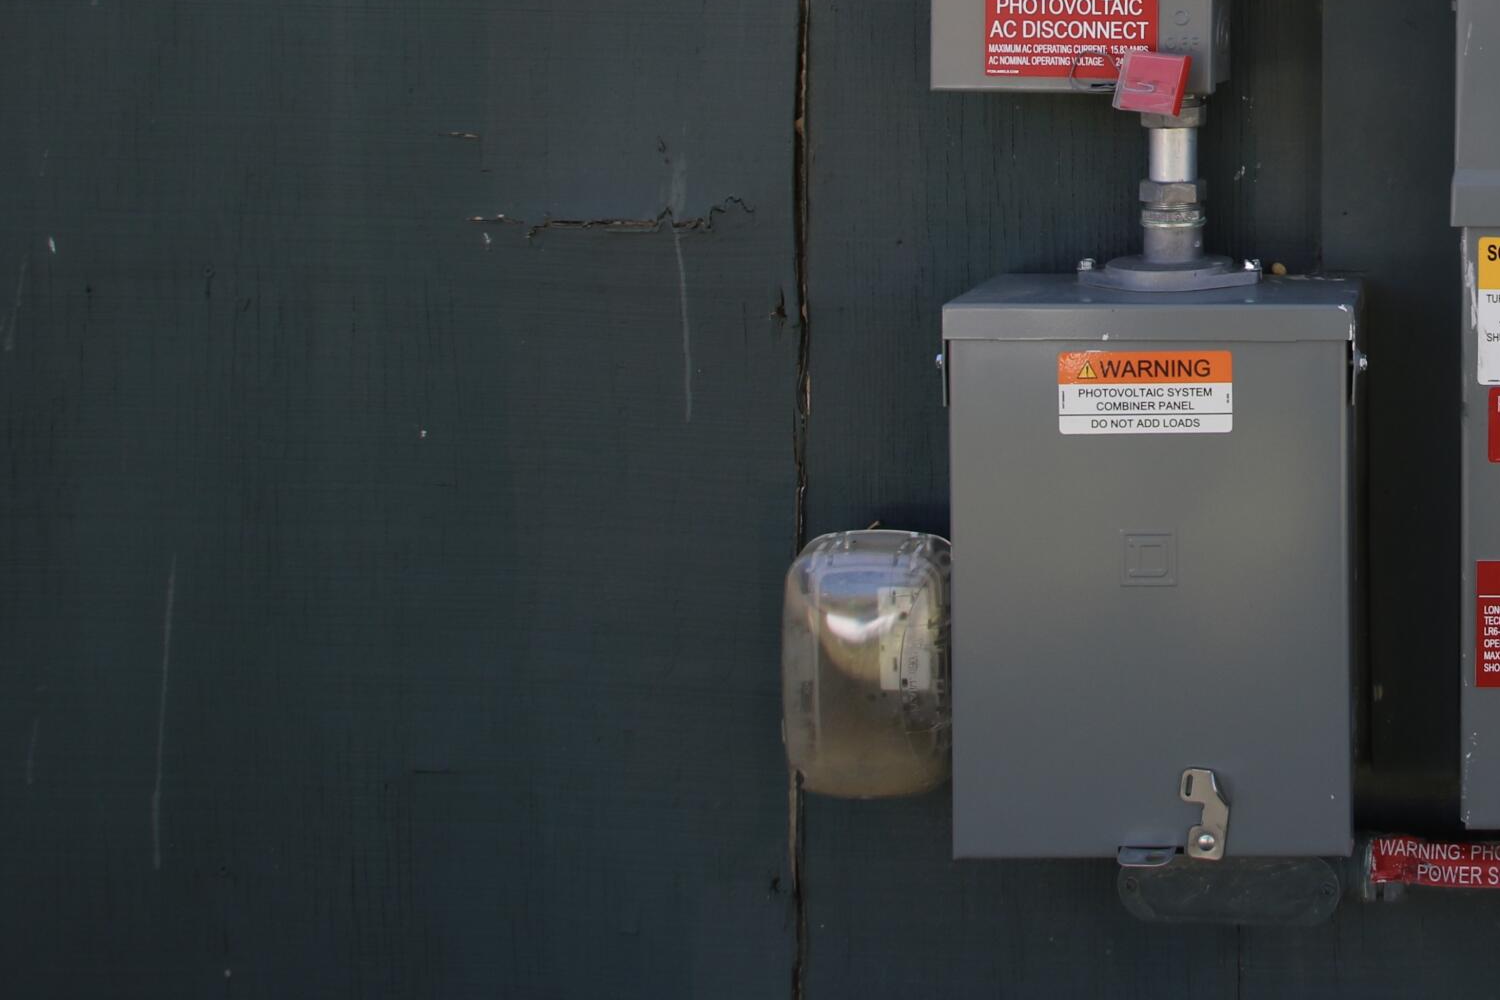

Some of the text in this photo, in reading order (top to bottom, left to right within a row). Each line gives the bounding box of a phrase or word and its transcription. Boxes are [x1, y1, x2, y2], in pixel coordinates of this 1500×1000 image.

[990, 21, 1148, 39] AC DISCONNECT
[1100, 359, 1210, 378] WARNING
[1079, 388, 1212, 398] PHOTOVOLTAIC SYSTEM
[1097, 401, 1194, 411] COMBINER PANEL
[1092, 419, 1200, 428] DO NOT ADD LOADS
[1379, 839, 1465, 860] WARNING:
[1417, 865, 1481, 884] POWER
